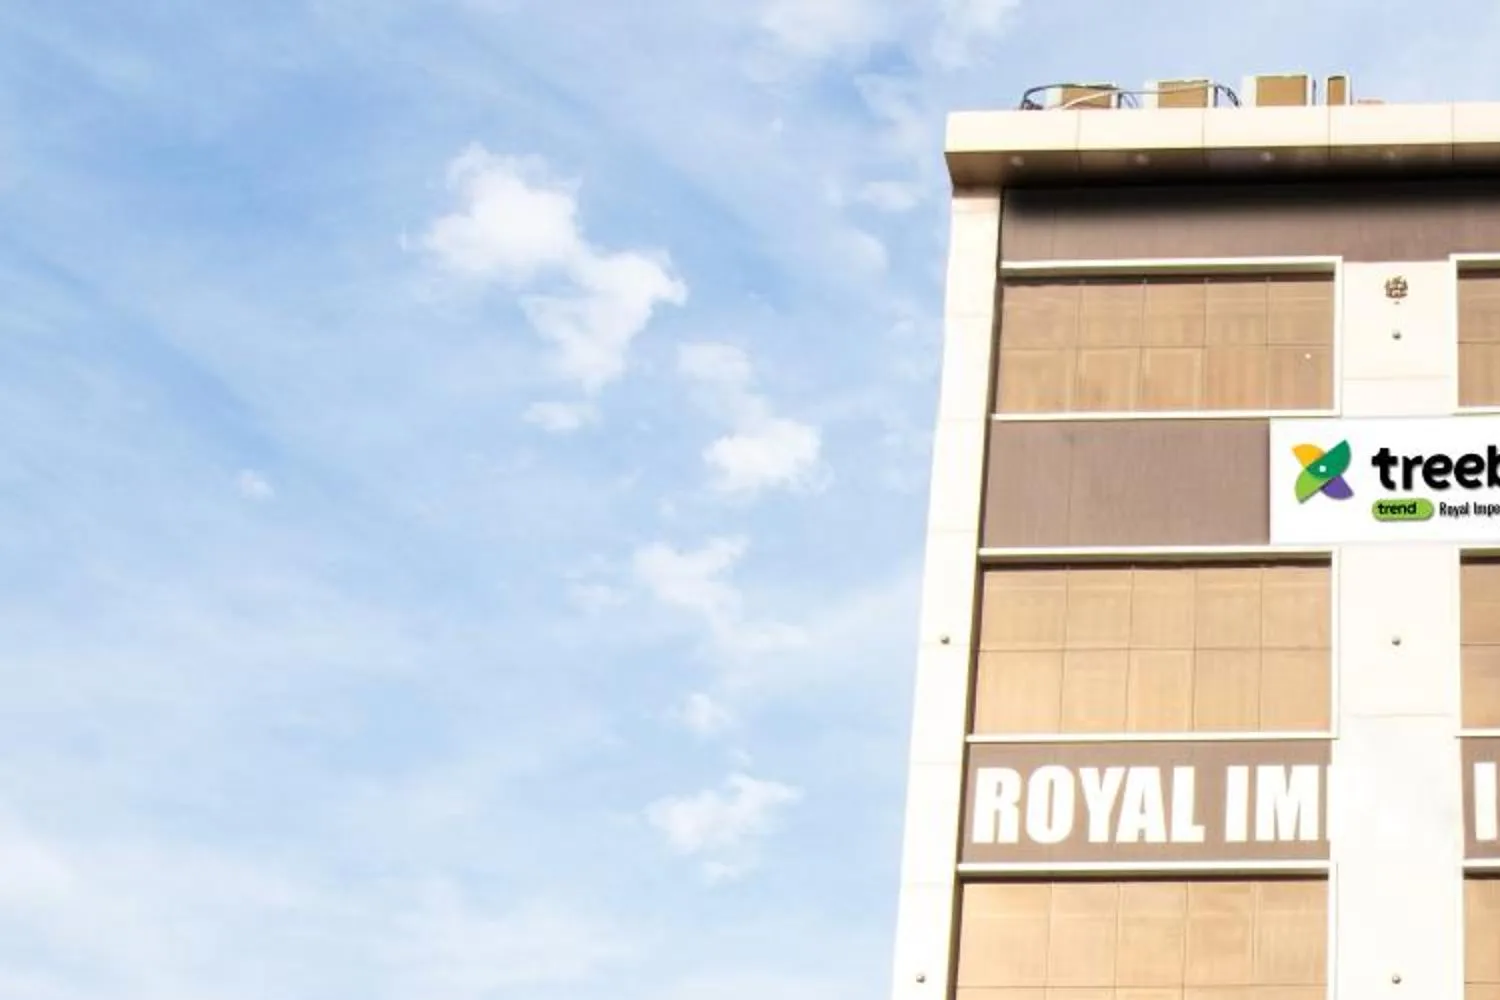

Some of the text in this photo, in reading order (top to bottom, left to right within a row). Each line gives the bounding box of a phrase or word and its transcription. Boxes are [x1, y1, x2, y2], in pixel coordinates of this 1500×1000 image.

[1377, 502, 1417, 515] trend
[1439, 501, 1470, 517] Royal
[972, 764, 1206, 844] ROYAL
